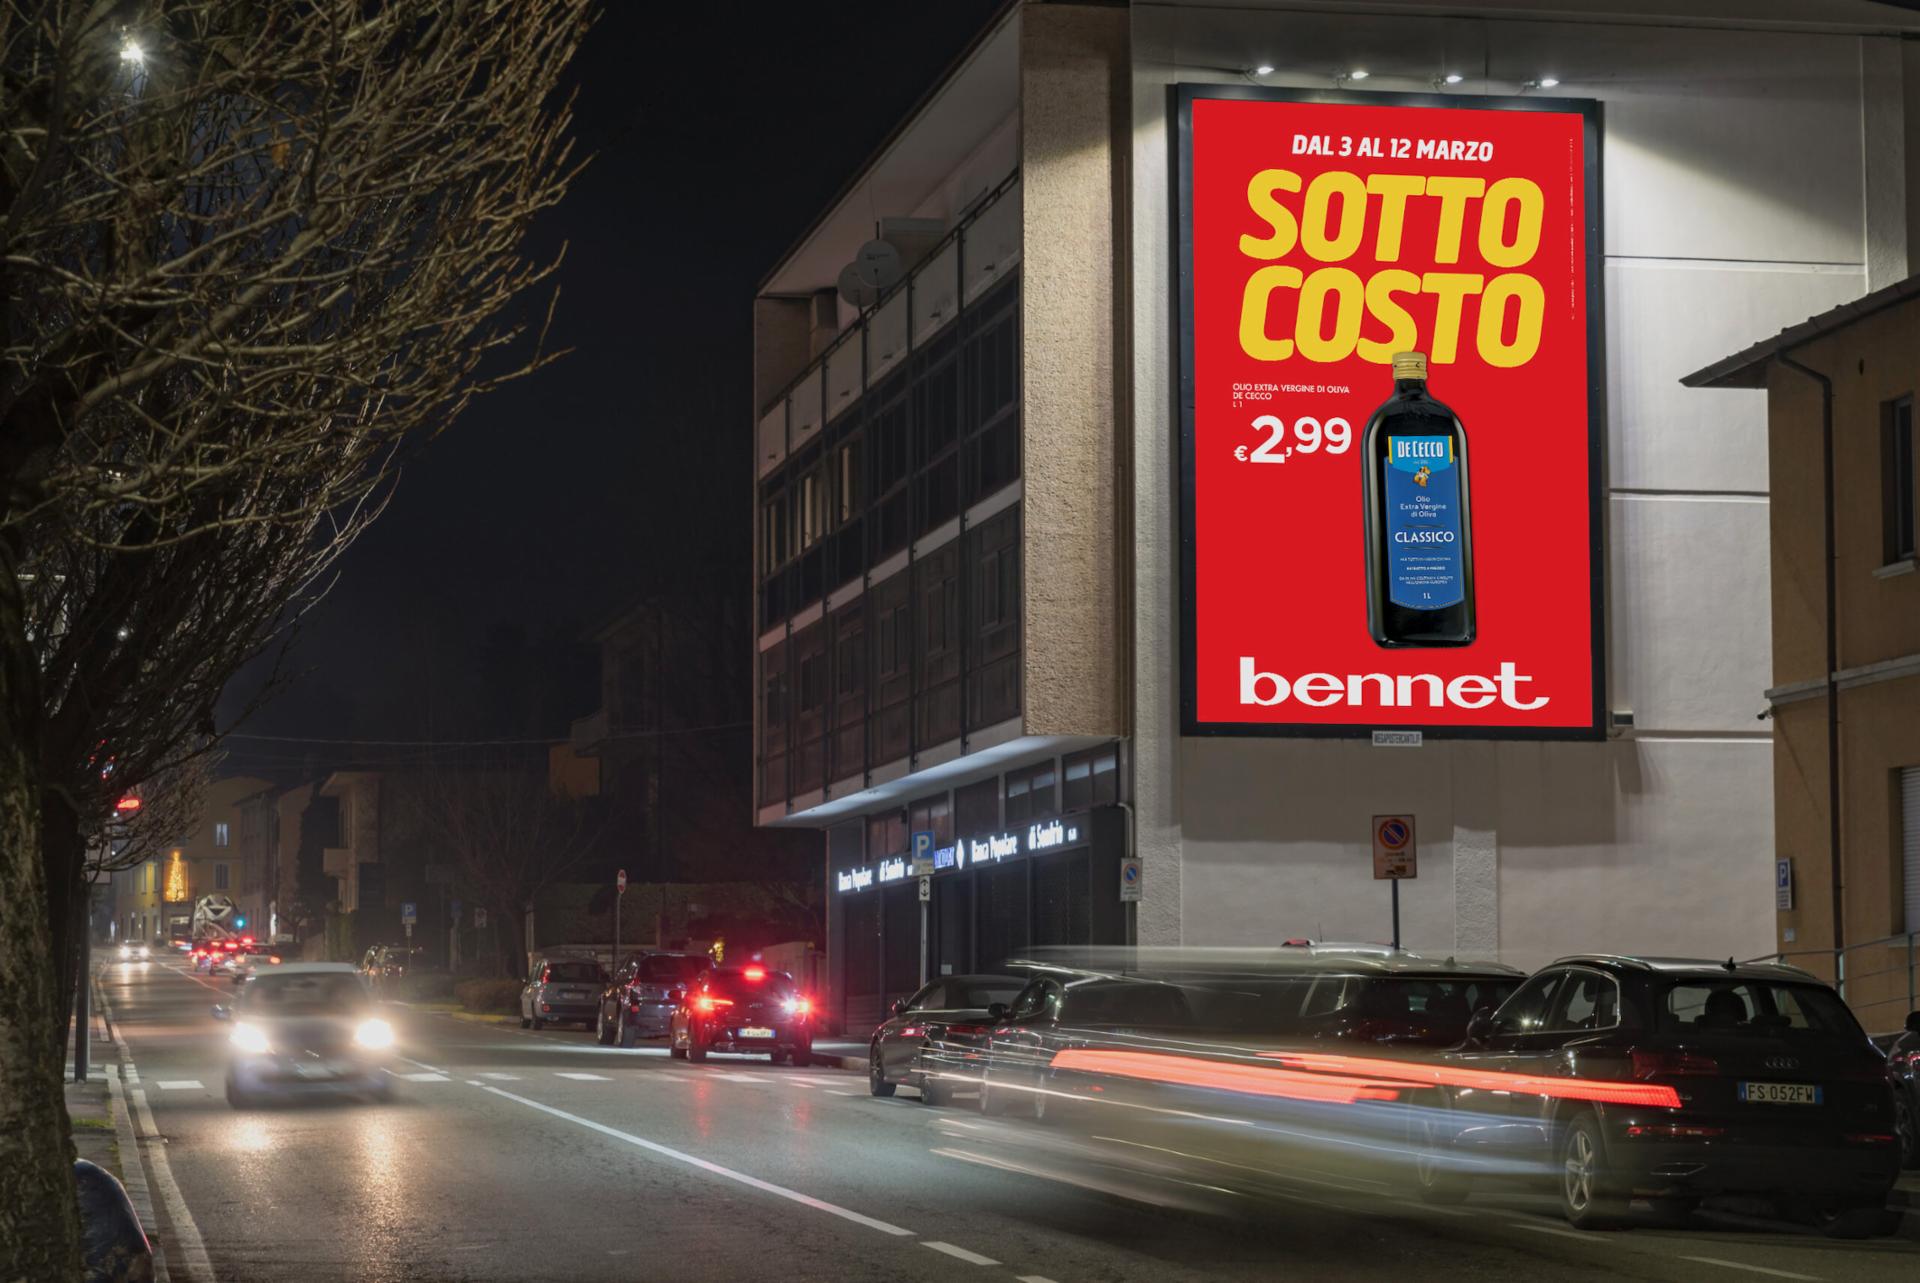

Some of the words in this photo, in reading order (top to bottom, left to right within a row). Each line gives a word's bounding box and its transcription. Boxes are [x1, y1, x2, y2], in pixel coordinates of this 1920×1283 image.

[1292, 135, 1334, 156] DAL
[1339, 136, 1352, 157] 3
[1357, 137, 1384, 158] AL
[1391, 138, 1411, 159] 12
[1416, 139, 1494, 163] MARZO
[1239, 169, 1545, 268] SOTTO
[1239, 265, 1545, 368] COSTO
[1232, 382, 1253, 392] OLIO
[1254, 383, 1279, 392] EXTRA
[1281, 384, 1315, 393] VERGINE
[1317, 385, 1326, 393] DI
[1327, 385, 1350, 394] OLIVA
[1232, 391, 1243, 400] DE
[1244, 392, 1273, 401] CECCO
[1397, 441, 1411, 458] DE
[1412, 441, 1444, 458] CECCO
[1395, 531, 1455, 543] CLASSICO
[1240, 657, 1550, 711] bennet
[917, 835, 930, 857] P
[1780, 864, 1787, 886] P
[405, 903, 414, 916] P
[1747, 1084, 1766, 1100] FS
